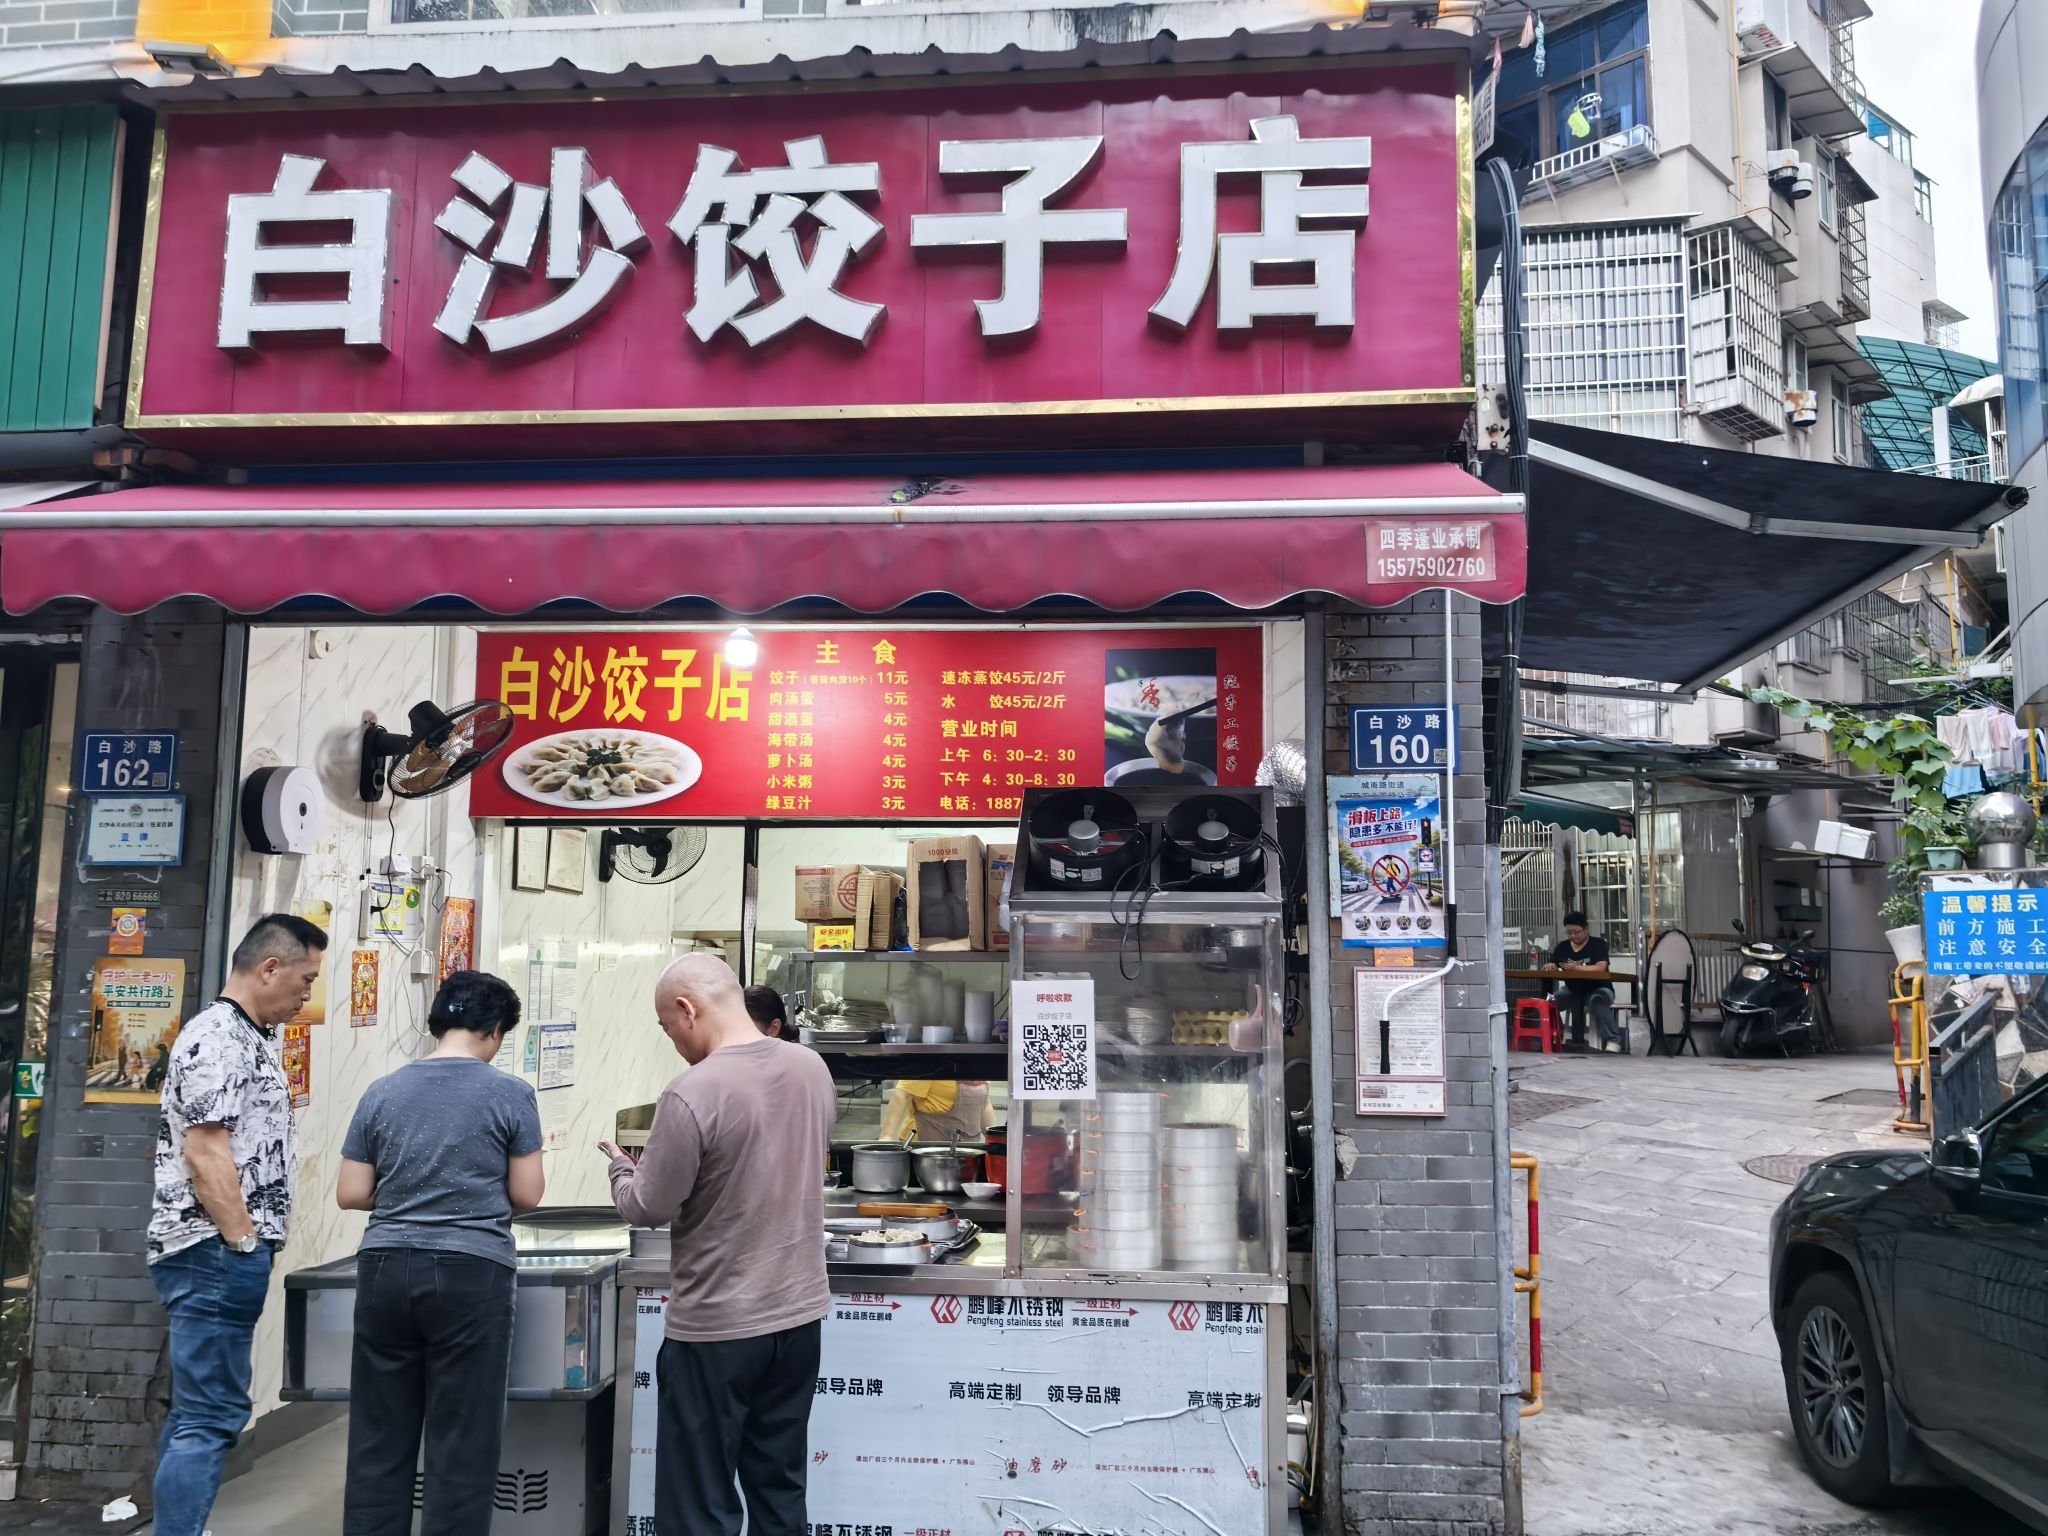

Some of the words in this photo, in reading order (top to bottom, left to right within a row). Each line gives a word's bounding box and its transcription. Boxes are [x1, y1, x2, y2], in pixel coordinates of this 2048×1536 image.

[216, 115, 1373, 351] 白沙饺子店
[1378, 556, 1486, 577] 15575902760
[815, 639, 900, 665] 主食
[500, 645, 753, 723] 白沙饺子店
[769, 670, 800, 685] 饺子
[877, 671, 909, 685] 11元
[942, 670, 1066, 685] 速冻蒸饺45元/2斤
[884, 691, 908, 705] 5元
[883, 712, 908, 726] 4元
[1369, 713, 1440, 730] 白沙路
[941, 719, 1017, 737] 营业时间
[98, 739, 162, 754] 白沙路
[767, 732, 813, 747] 海带汤
[882, 733, 907, 747] 4元
[939, 747, 971, 763] 上午
[1369, 734, 1430, 765] 160
[767, 753, 813, 768] 萝卜汤
[881, 754, 906, 768] 4元
[97, 758, 150, 787] 162
[939, 771, 971, 787] 下午
[766, 774, 812, 789] 小米粥
[882, 775, 906, 789] 3元
[765, 795, 812, 810] 绿豆汁
[881, 796, 906, 810] 3元
[1941, 894, 2038, 914] 温馨提示
[1938, 918, 2047, 936] 前方施工
[1938, 938, 2047, 957] 注意安全
[1933, 961, 2048, 971] 因施工带来的不便敬请谅
[836, 1310, 893, 1321] 黄金品质在鹏峰
[967, 1315, 1004, 1327] Pengfeng
[1006, 1317, 1042, 1327] stainless
[1045, 1318, 1064, 1328] steel
[1072, 1317, 1130, 1328] 黄金品质在鹏峰
[1205, 1323, 1242, 1335] Pengfeng
[634, 1371, 650, 1389] 牌
[814, 1377, 884, 1397] 领导品牌
[949, 1381, 1022, 1401] 高端定制
[1047, 1384, 1121, 1405] 领导品牌
[1187, 1390, 1262, 1409] 高端定制
[1005, 1456, 1068, 1475] 油磨砂
